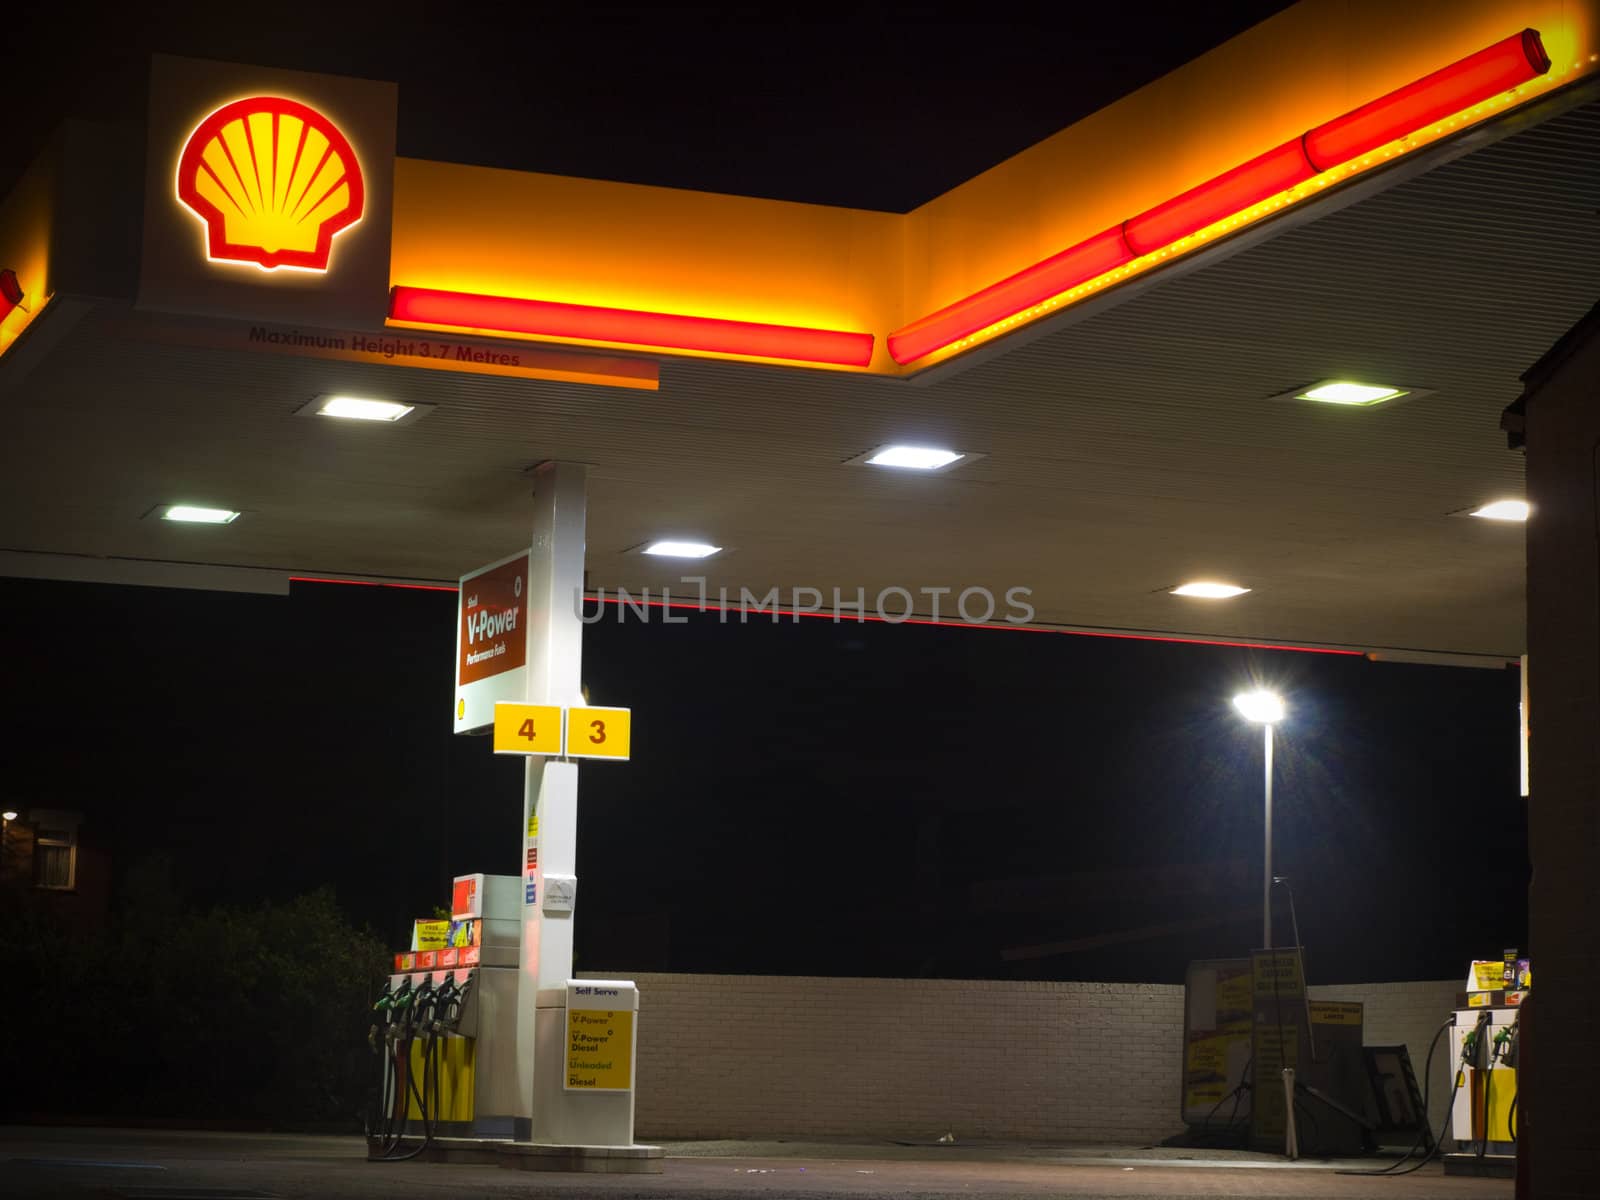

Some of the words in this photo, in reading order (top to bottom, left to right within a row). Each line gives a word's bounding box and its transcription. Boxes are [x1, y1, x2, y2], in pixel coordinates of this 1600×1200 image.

[249, 326, 345, 350] Maximum
[351, 336, 415, 358] Height
[419, 342, 450, 359] 3.7
[456, 345, 520, 367] Metres
[467, 607, 518, 645] V-Power
[466, 649, 494, 666] Performance
[518, 718, 537, 741] 4
[589, 719, 607, 744] 3
[575, 987, 592, 995] Self
[594, 987, 618, 996] Serve
[573, 1016, 608, 1024] V-Power
[573, 1034, 608, 1042] V-Power
[572, 1043, 598, 1051] Diesel
[570, 1061, 612, 1069] Unleaded
[569, 1077, 596, 1086] Diesel
